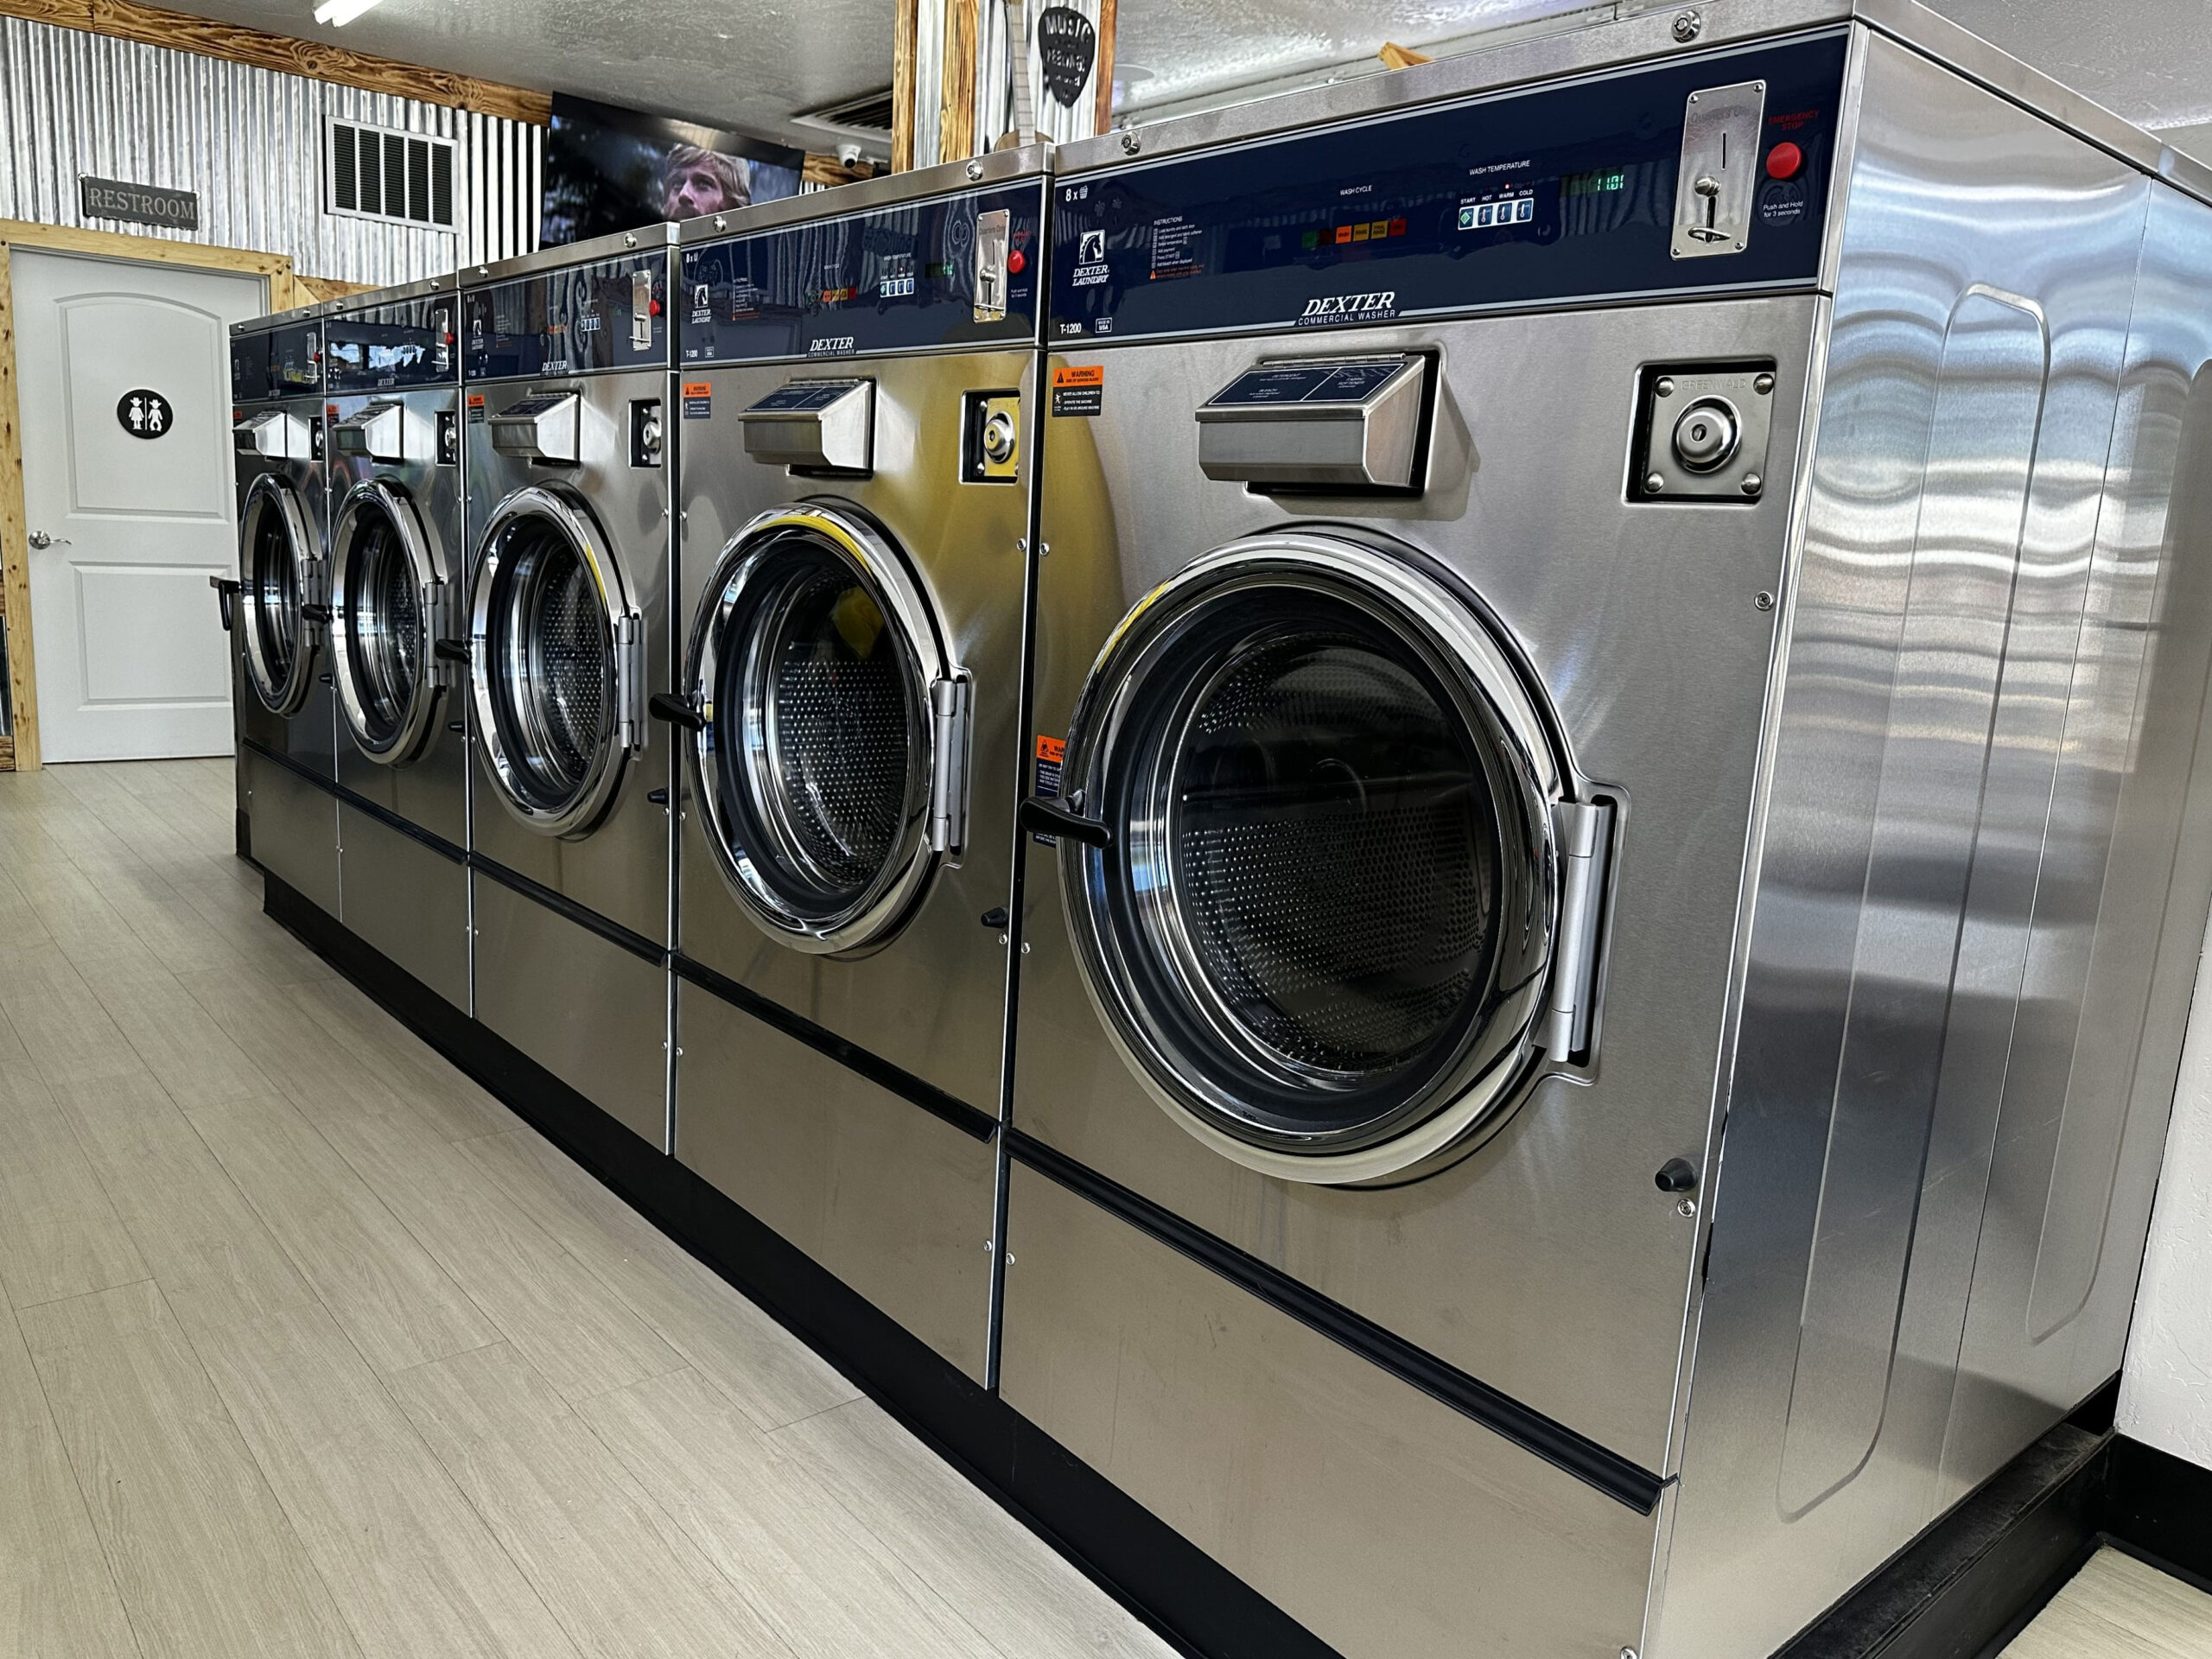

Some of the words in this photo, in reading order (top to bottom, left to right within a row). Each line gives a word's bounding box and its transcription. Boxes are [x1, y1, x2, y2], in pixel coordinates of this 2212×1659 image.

[1045, 14, 1091, 42] MUSIC
[1469, 167, 1486, 175] WASH
[1487, 159, 1531, 173] TEMPERATURE
[1065, 188, 1071, 202] 8
[1340, 188, 1355, 196] WASH
[1355, 185, 1372, 194] CYCLE
[89, 188, 195, 220] RESTROOM
[1072, 264, 1109, 278] DEXTER
[1071, 274, 1109, 286] LAUNDRY
[1300, 290, 1395, 317] DEXTER
[691, 308, 711, 317] DEXTER
[1298, 314, 1354, 326] COMMERCIAL
[1357, 309, 1395, 321] WASHER
[1059, 322, 1082, 334] T-1200
[809, 336, 855, 352] DEXTER
[542, 359, 568, 372] DEXTER
